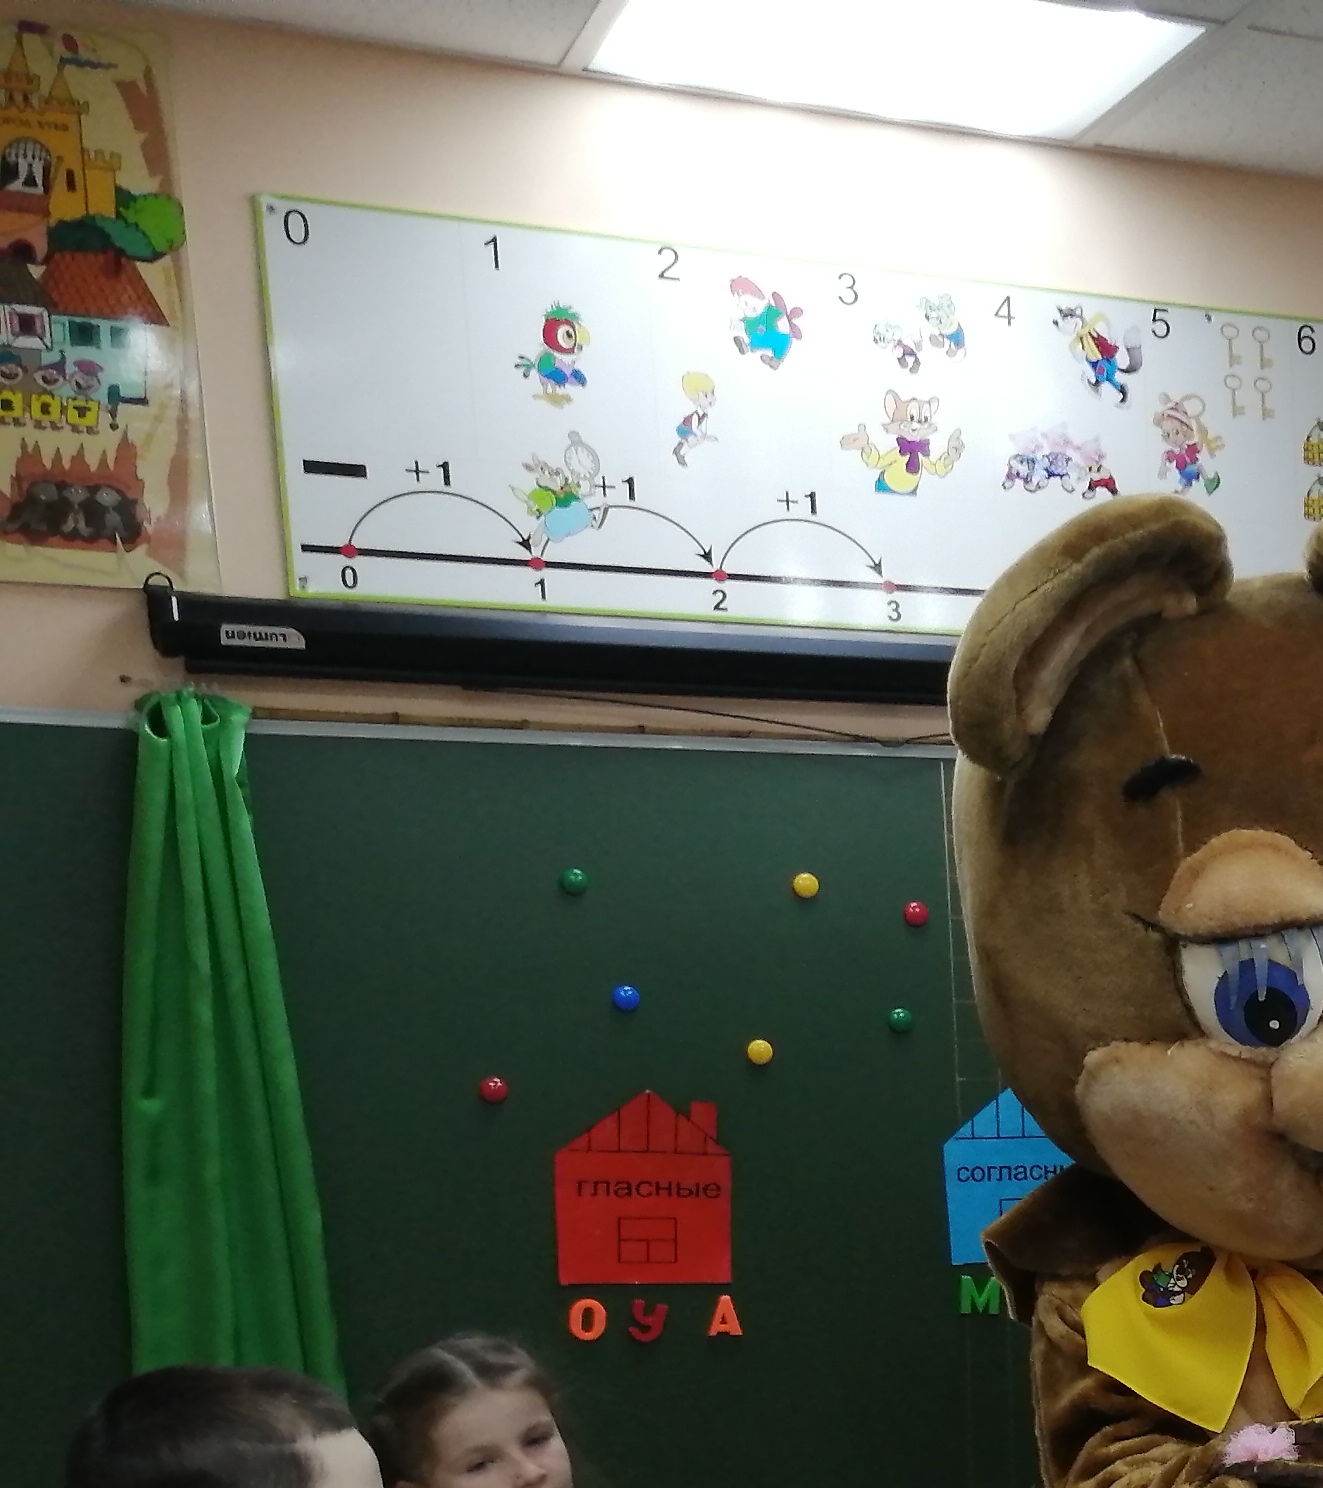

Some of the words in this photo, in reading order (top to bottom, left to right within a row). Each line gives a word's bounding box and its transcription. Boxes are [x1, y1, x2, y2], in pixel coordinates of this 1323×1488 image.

[284, 209, 309, 245] 0
[484, 236, 500, 271] 1
[657, 246, 680, 282] 2
[837, 273, 859, 306] 3
[994, 295, 1016, 327] 4
[1151, 307, 1171, 340] 5
[1297, 324, 1316, 356] 6
[341, 566, 358, 590] 0
[535, 578, 547, 601] 1
[711, 590, 728, 612] 2
[886, 600, 902, 623] 3
[577, 1180, 722, 1198] гласные
[957, 1164, 1065, 1182] согласн
[568, 1298, 607, 1341] О
[628, 1299, 669, 1342] У
[708, 1294, 743, 1336] А
